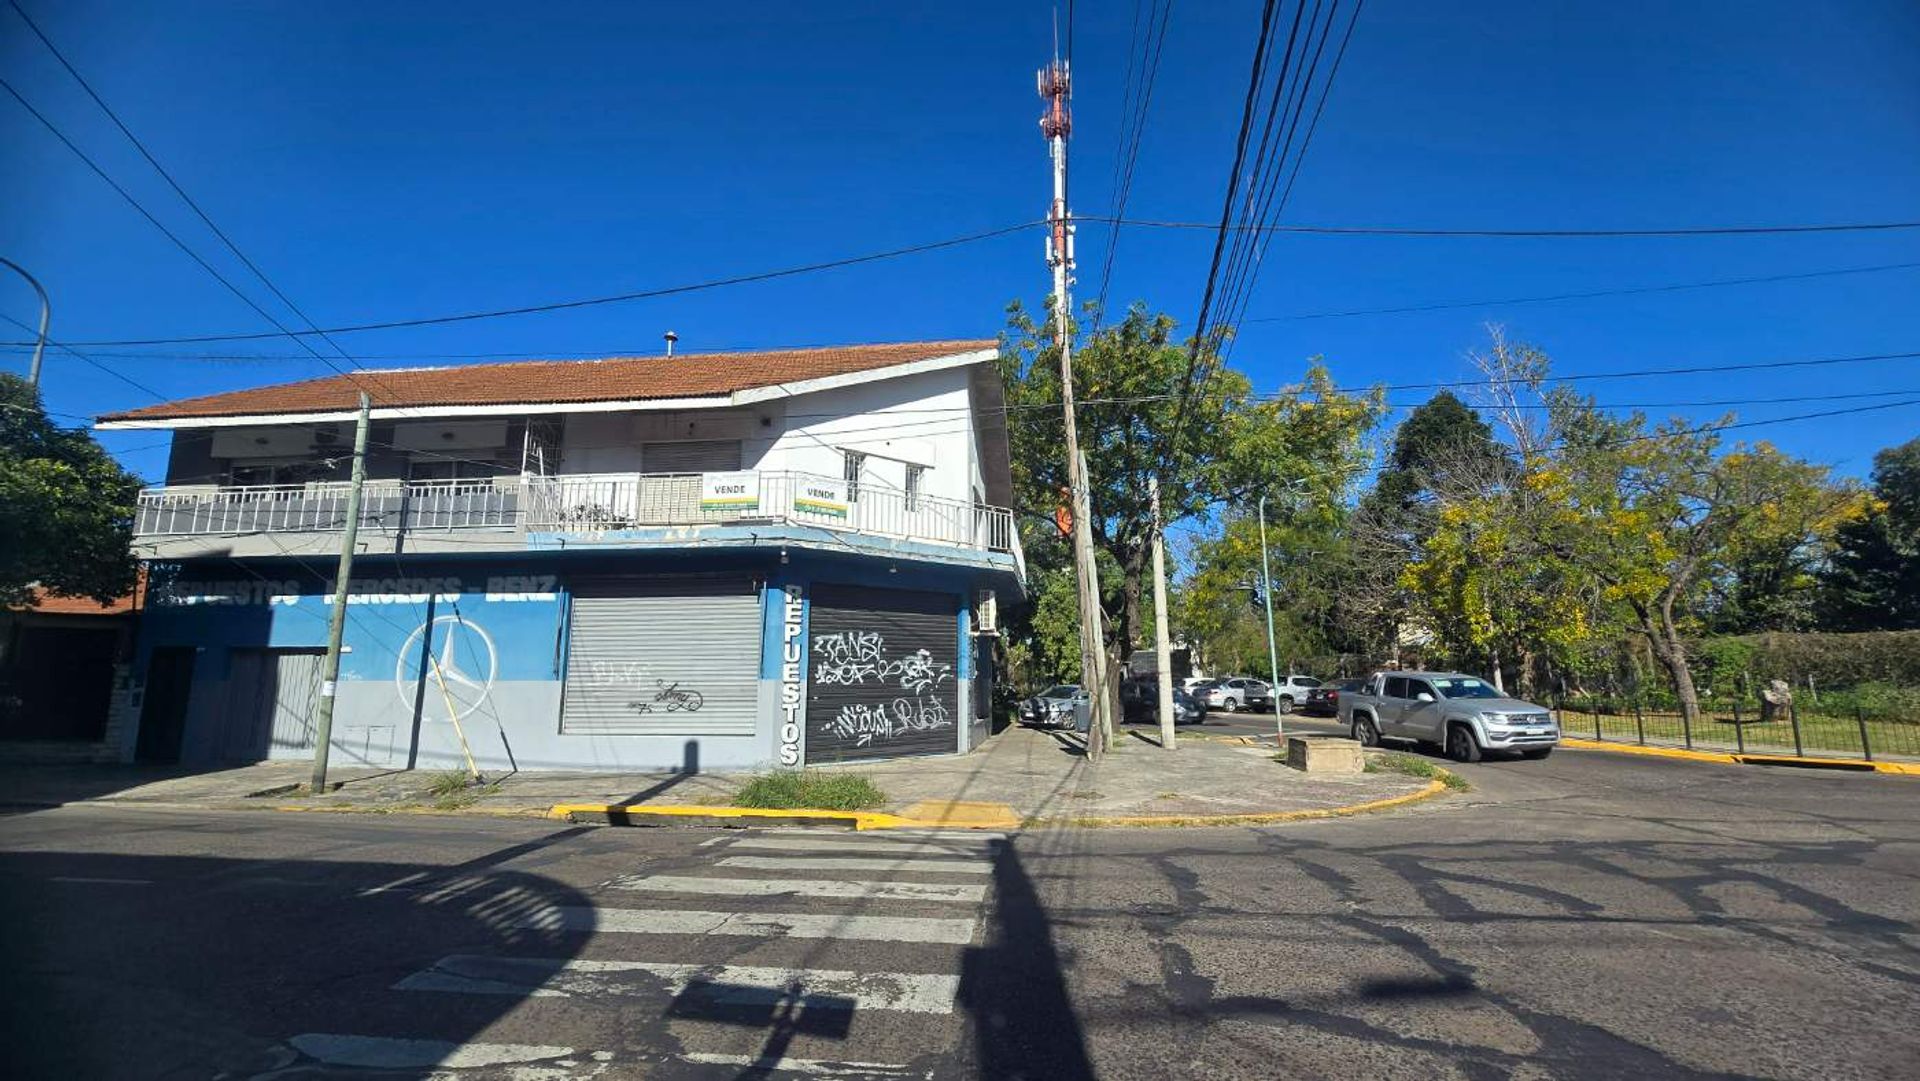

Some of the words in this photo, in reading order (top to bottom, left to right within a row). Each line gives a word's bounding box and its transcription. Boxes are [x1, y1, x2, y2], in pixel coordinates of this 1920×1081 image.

[714, 485, 746, 494] VENDE
[807, 487, 836, 500] VENDE
[485, 574, 559, 603] BENZ
[779, 584, 803, 766] REPUESTOS
